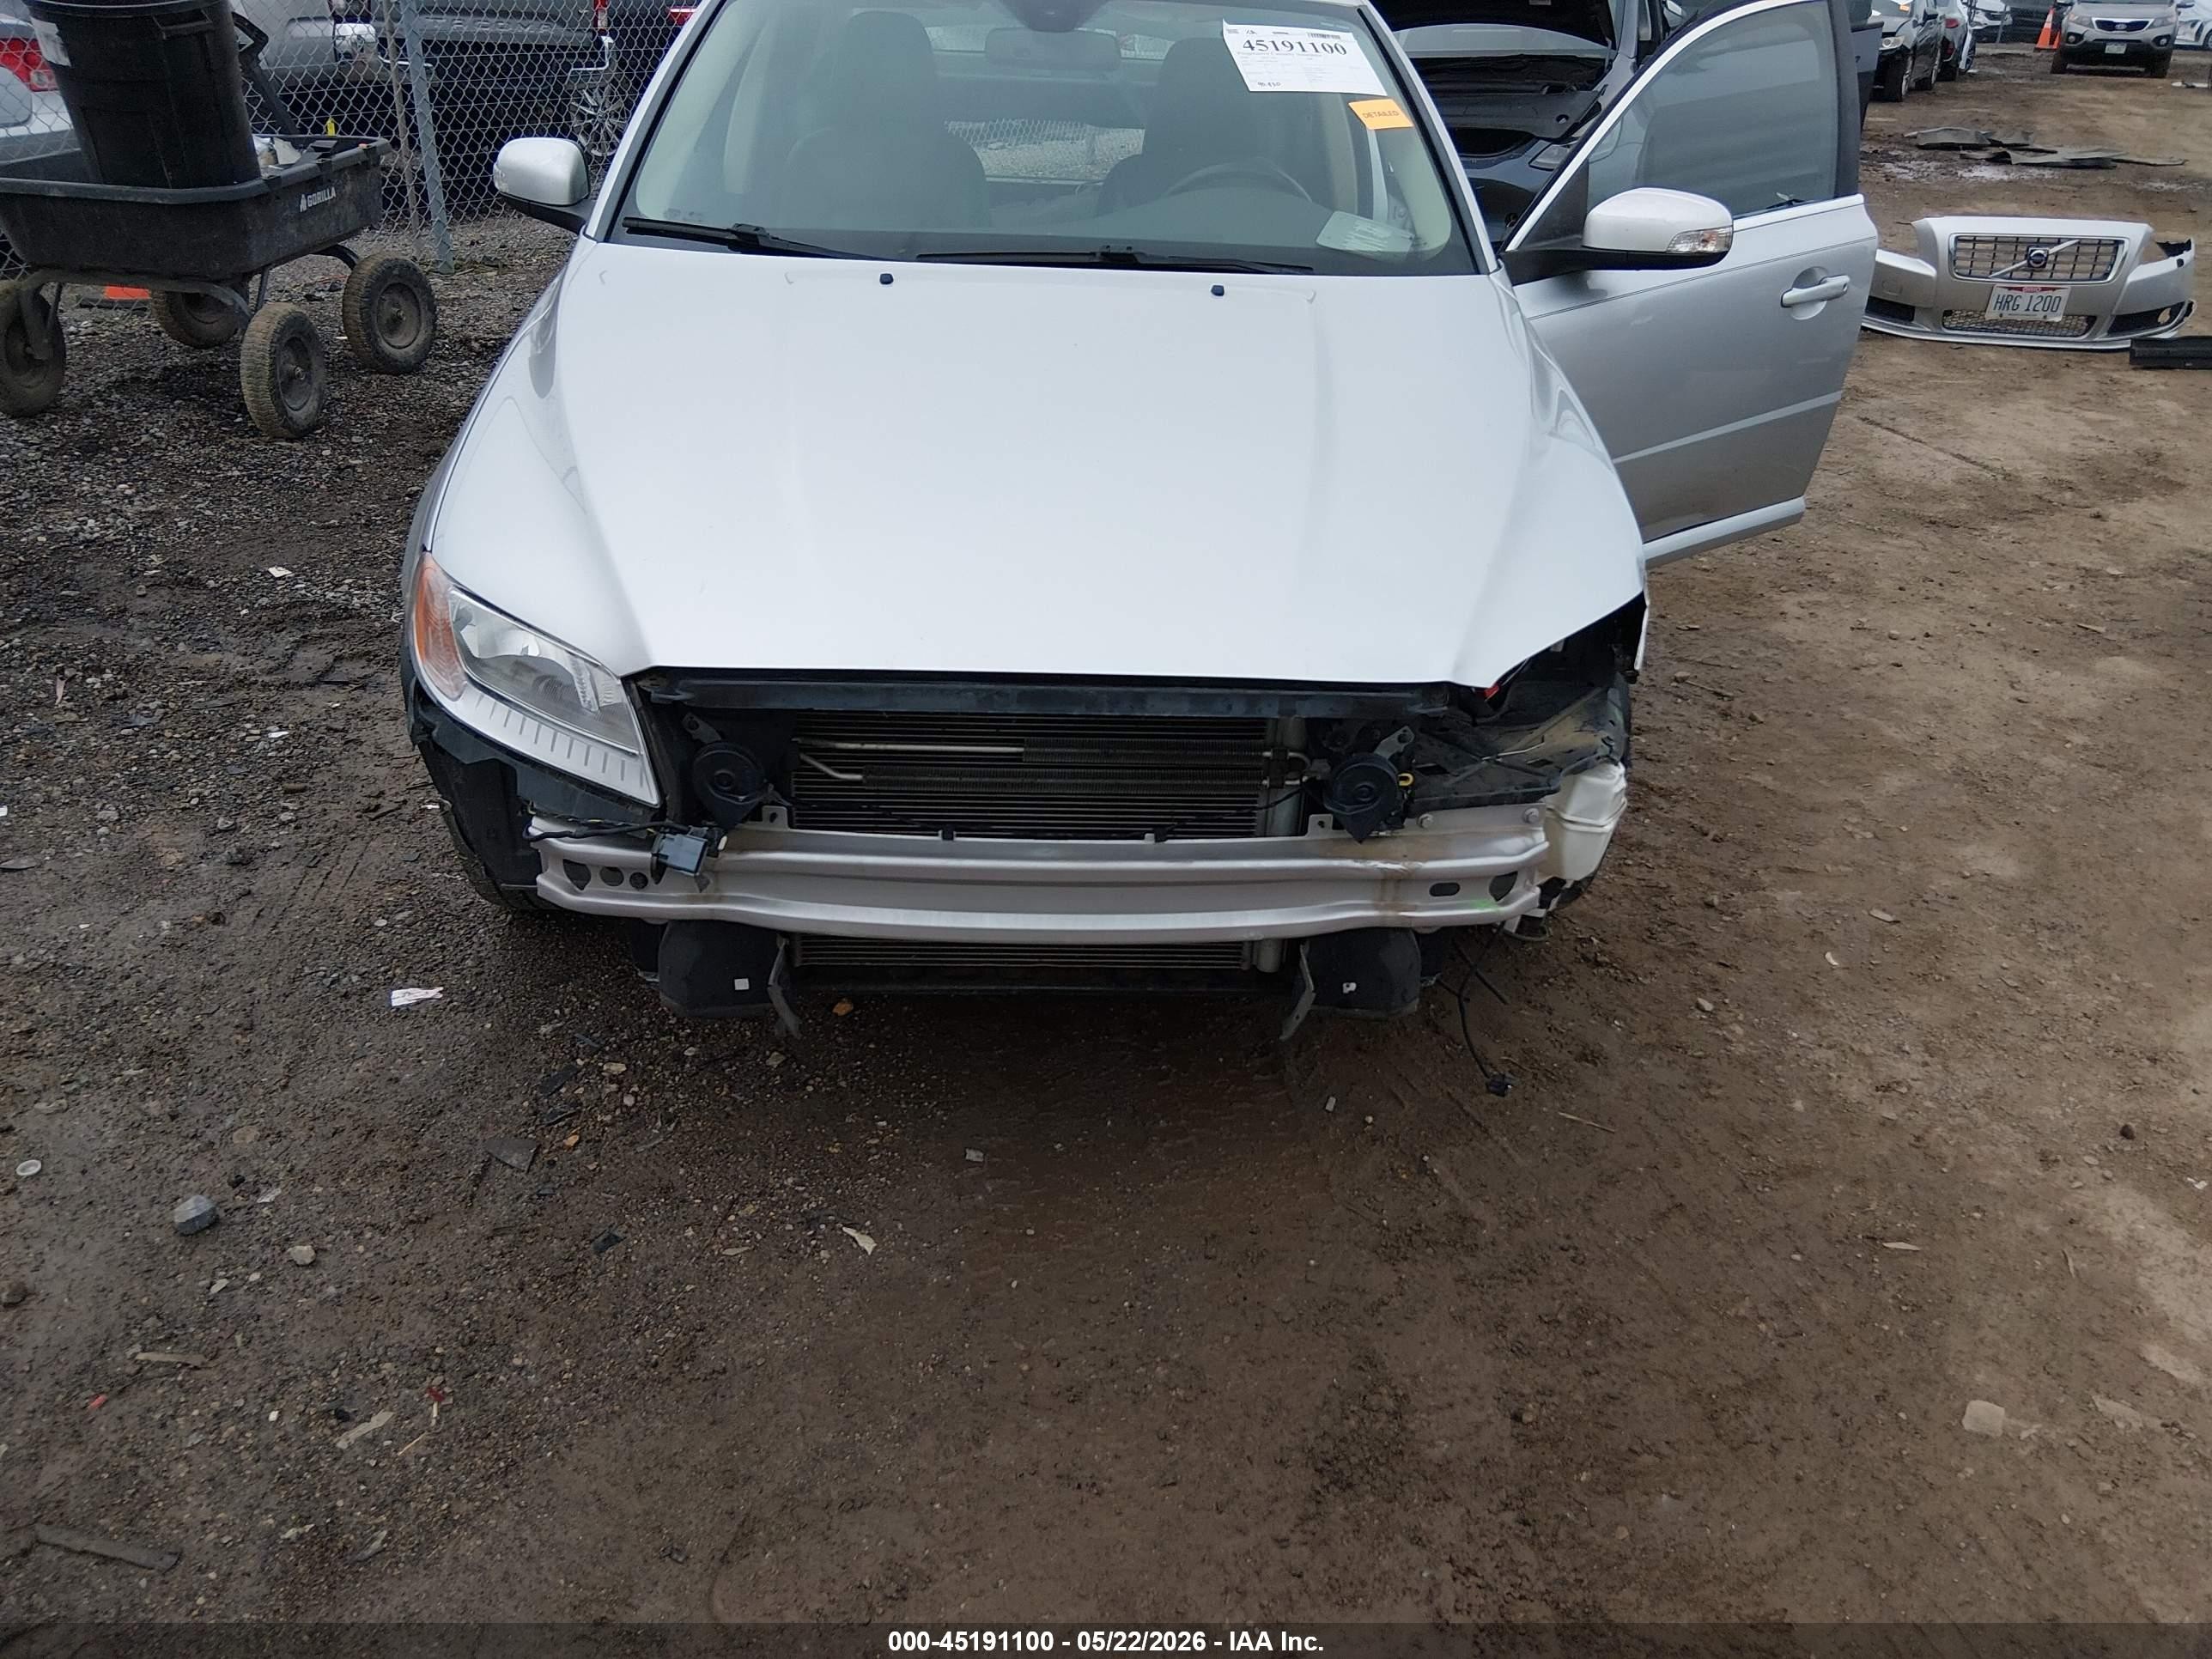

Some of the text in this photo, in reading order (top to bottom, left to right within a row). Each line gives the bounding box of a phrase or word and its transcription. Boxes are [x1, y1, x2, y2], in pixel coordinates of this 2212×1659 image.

[1243, 40, 1347, 55] 45191100
[307, 186, 337, 207] GORILLA
[1993, 294, 2062, 313] HRG 1200
